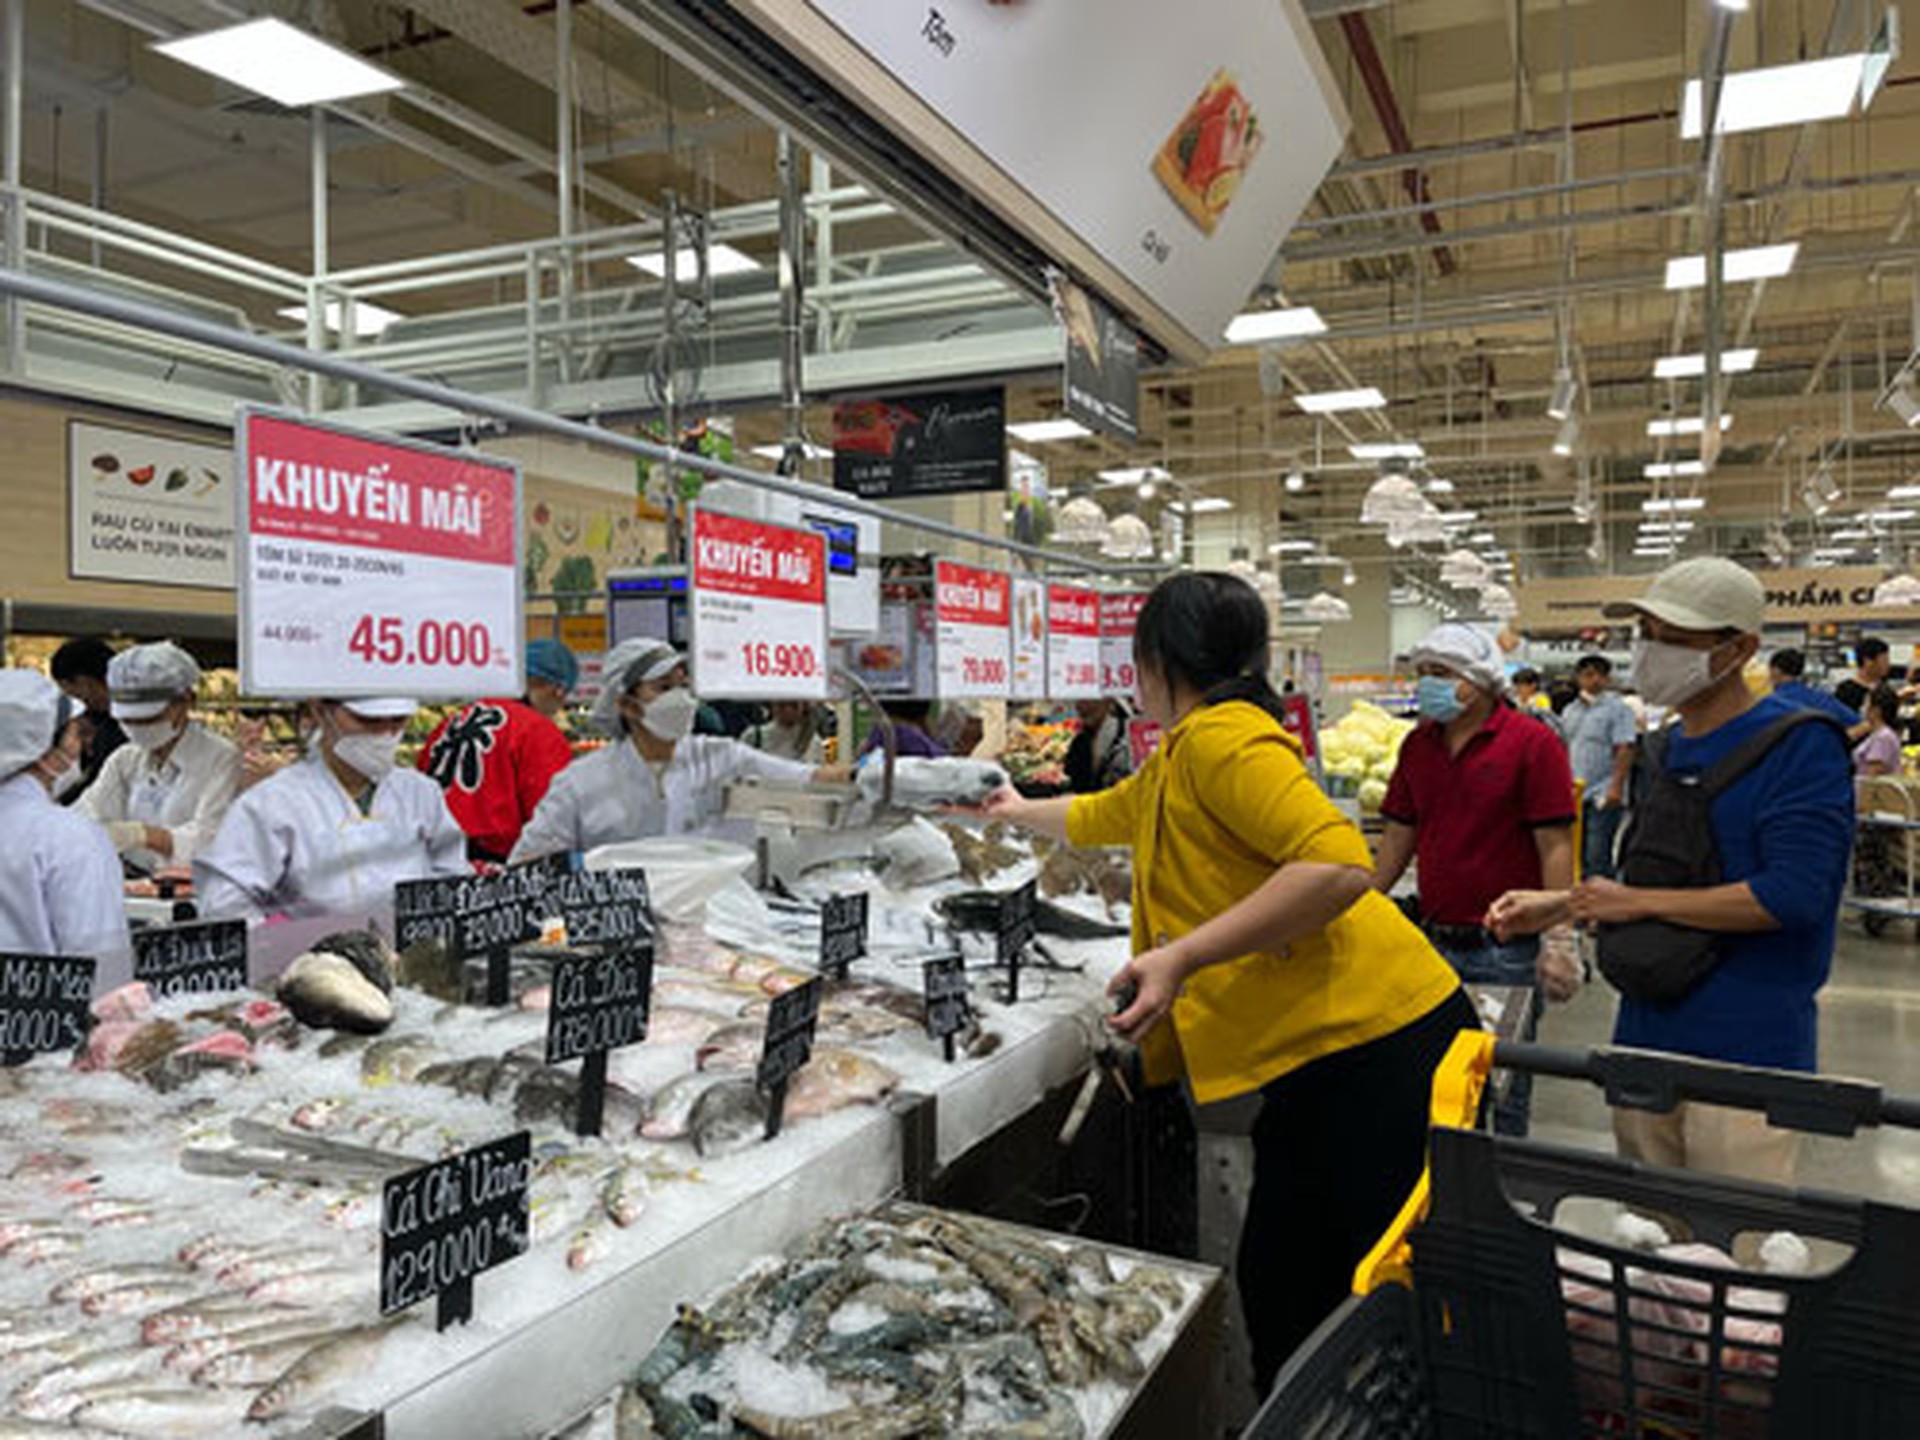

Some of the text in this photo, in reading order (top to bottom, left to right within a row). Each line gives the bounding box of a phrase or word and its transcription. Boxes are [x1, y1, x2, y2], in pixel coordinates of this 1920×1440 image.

[921, 6, 957, 58] Tôm
[256, 455, 412, 525] KHUYẾN
[421, 481, 483, 540] MÃI
[698, 535, 773, 579] KHUYẾN
[349, 614, 490, 667] 45.000
[742, 642, 815, 678] 16.900
[379, 1176, 420, 1238] Cá
